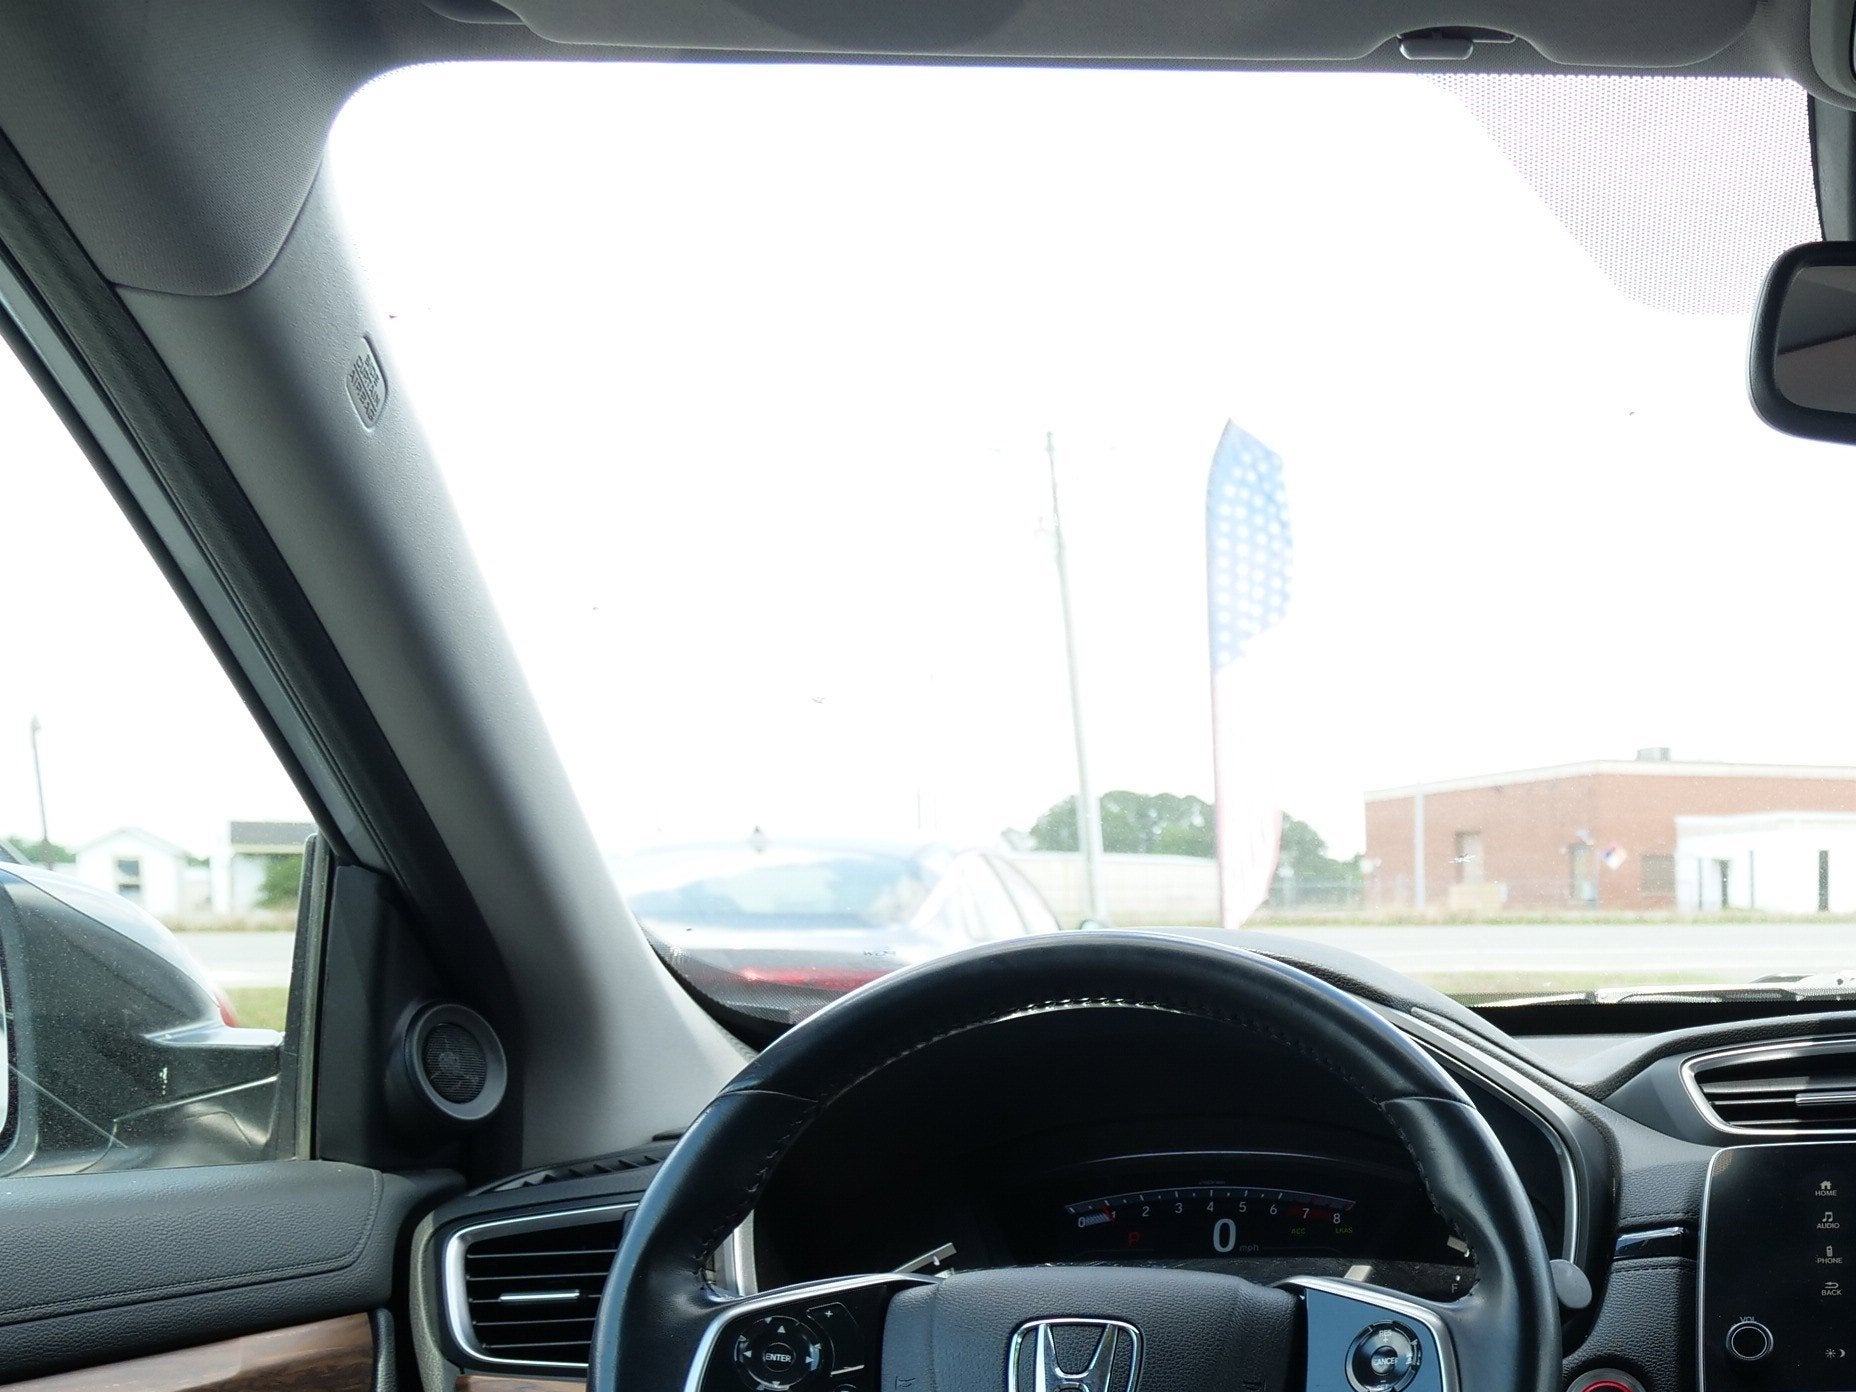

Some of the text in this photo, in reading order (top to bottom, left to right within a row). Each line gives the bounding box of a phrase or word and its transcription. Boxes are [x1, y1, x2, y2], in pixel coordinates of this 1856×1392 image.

[1814, 1189, 1838, 1197] HOME
[1142, 1206, 1150, 1217] 2
[1175, 1202, 1183, 1214] 3
[1206, 1201, 1214, 1212] 4
[1238, 1201, 1247, 1213] 5
[1269, 1204, 1278, 1215] 6
[1302, 1207, 1310, 1219] 7
[1332, 1213, 1341, 1224] 8
[1816, 1222, 1841, 1230] AUDIO
[1212, 1218, 1237, 1253] 0
[1239, 1244, 1260, 1253] mph
[765, 1353, 792, 1363] ENTER
